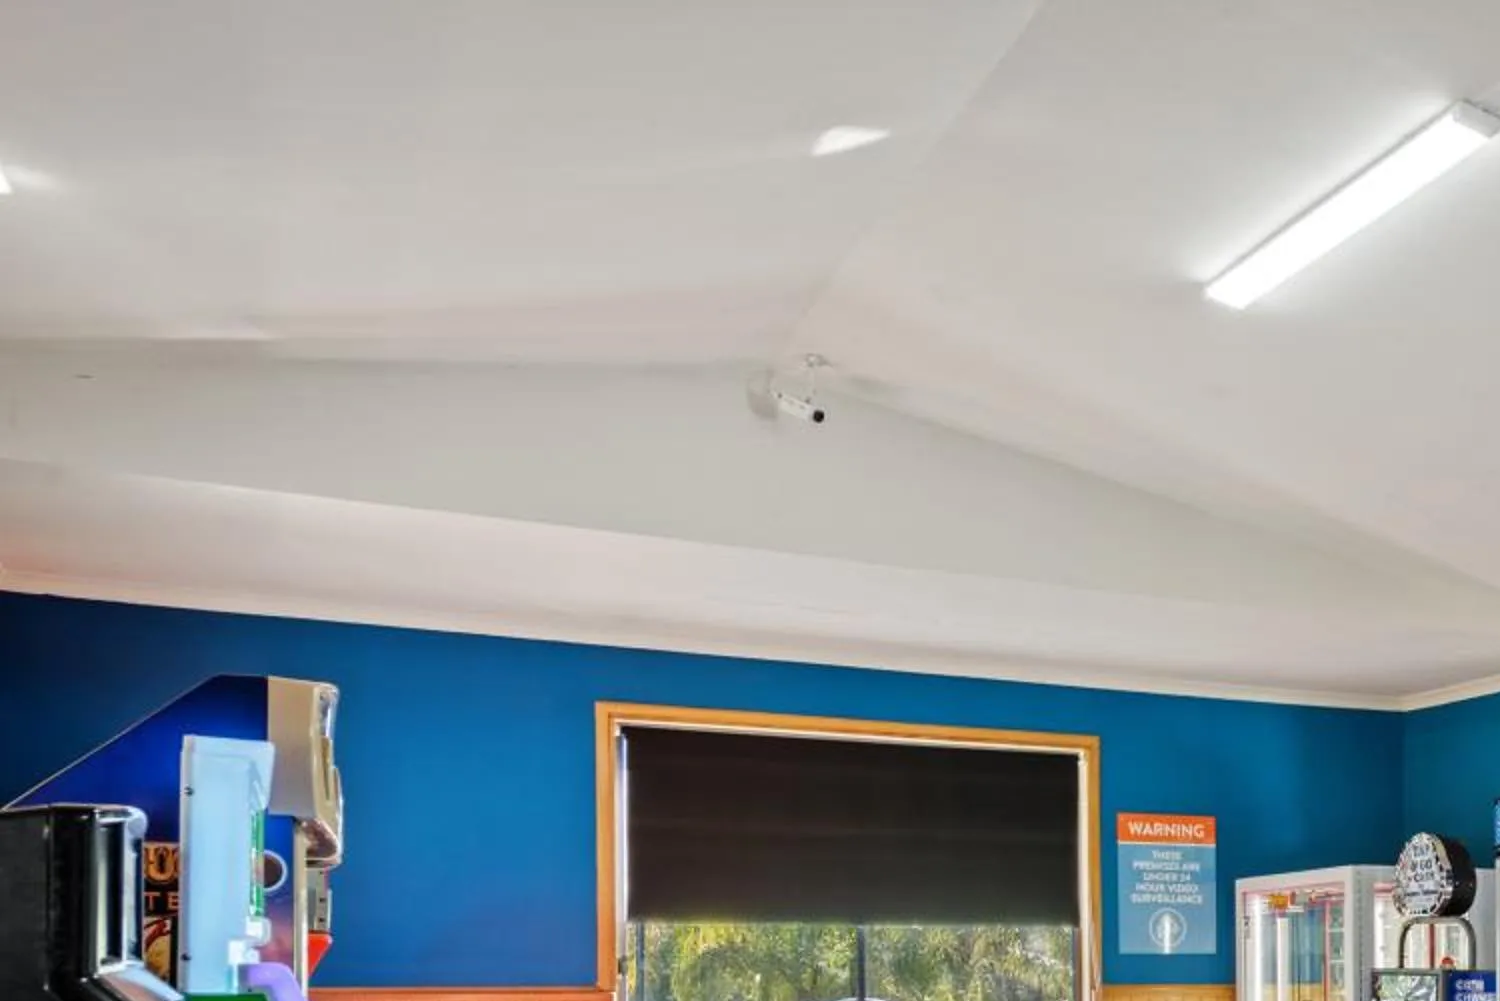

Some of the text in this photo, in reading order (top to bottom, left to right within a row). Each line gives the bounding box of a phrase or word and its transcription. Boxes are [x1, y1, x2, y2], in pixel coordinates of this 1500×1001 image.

[1128, 821, 1205, 839] WARNING
[1143, 872, 1177, 882] UNDER
[1136, 883, 1199, 894] HOUR VIDEO
[1131, 894, 1203, 905] SURVEILLANCE
